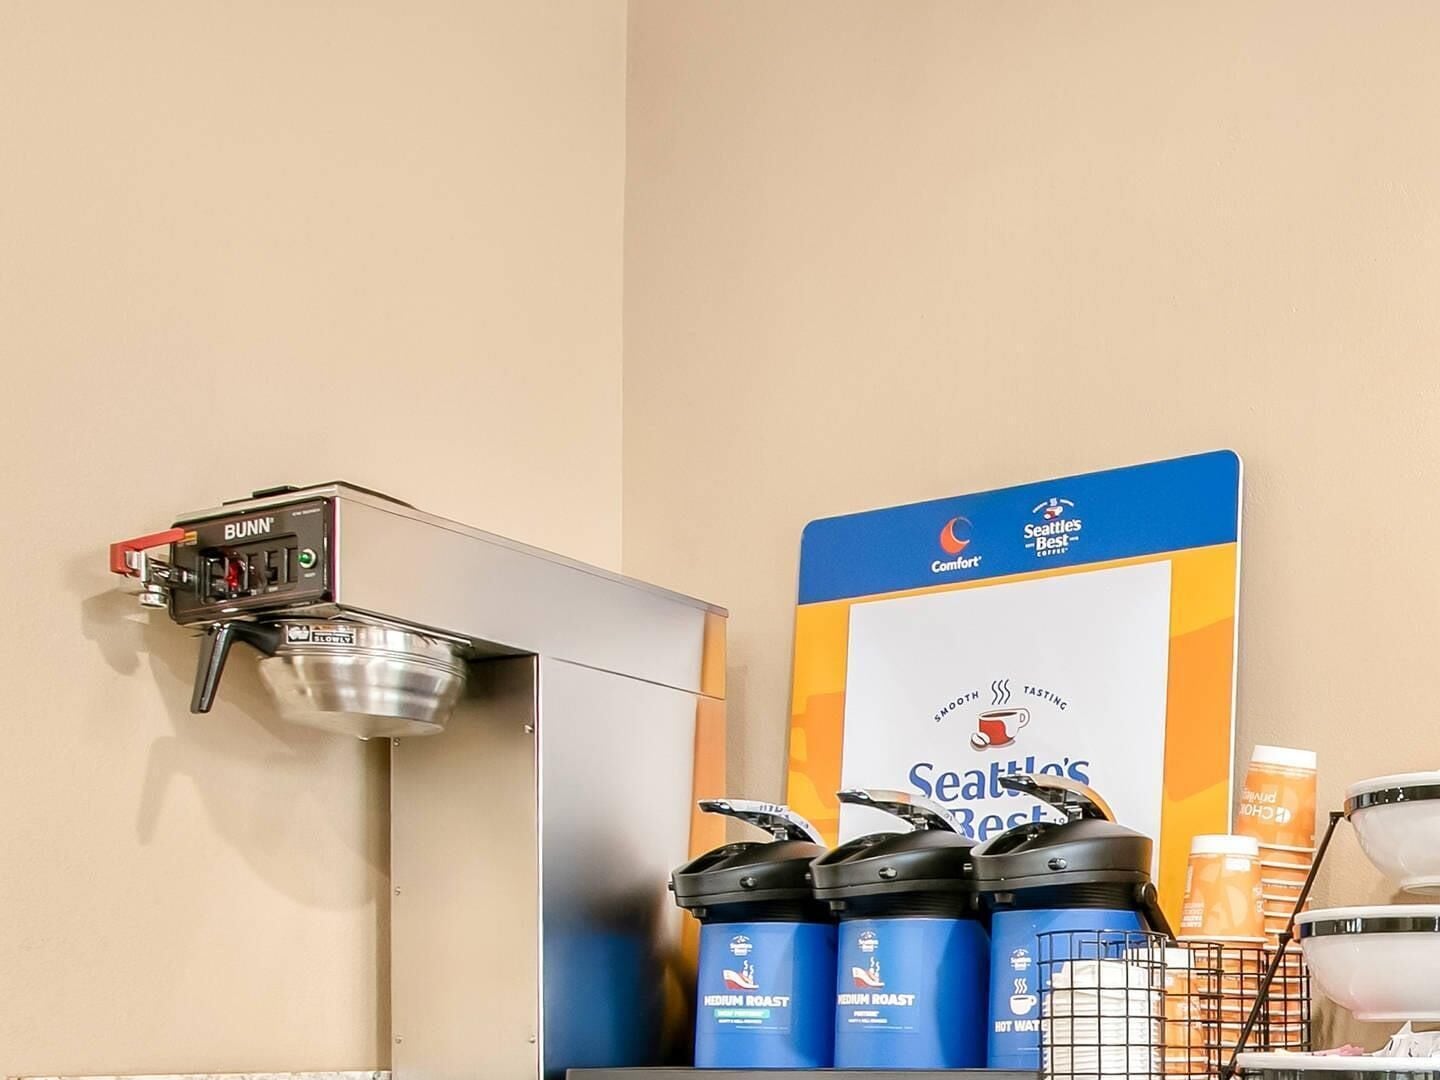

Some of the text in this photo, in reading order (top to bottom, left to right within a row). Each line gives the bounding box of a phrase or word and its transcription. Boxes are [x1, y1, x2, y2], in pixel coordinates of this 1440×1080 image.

[224, 517, 271, 540] BUNN
[1023, 518, 1082, 539] Seattle's
[1035, 534, 1069, 551] Best
[931, 556, 979, 573] Comfort
[314, 635, 352, 644] SLOWLY
[934, 685, 1068, 723] SMOOTH TASTING
[703, 995, 790, 1007] MEDIUM ROAST
[838, 993, 915, 1006] MEDIUM ROAST
[995, 1021, 1012, 1033] HOT
